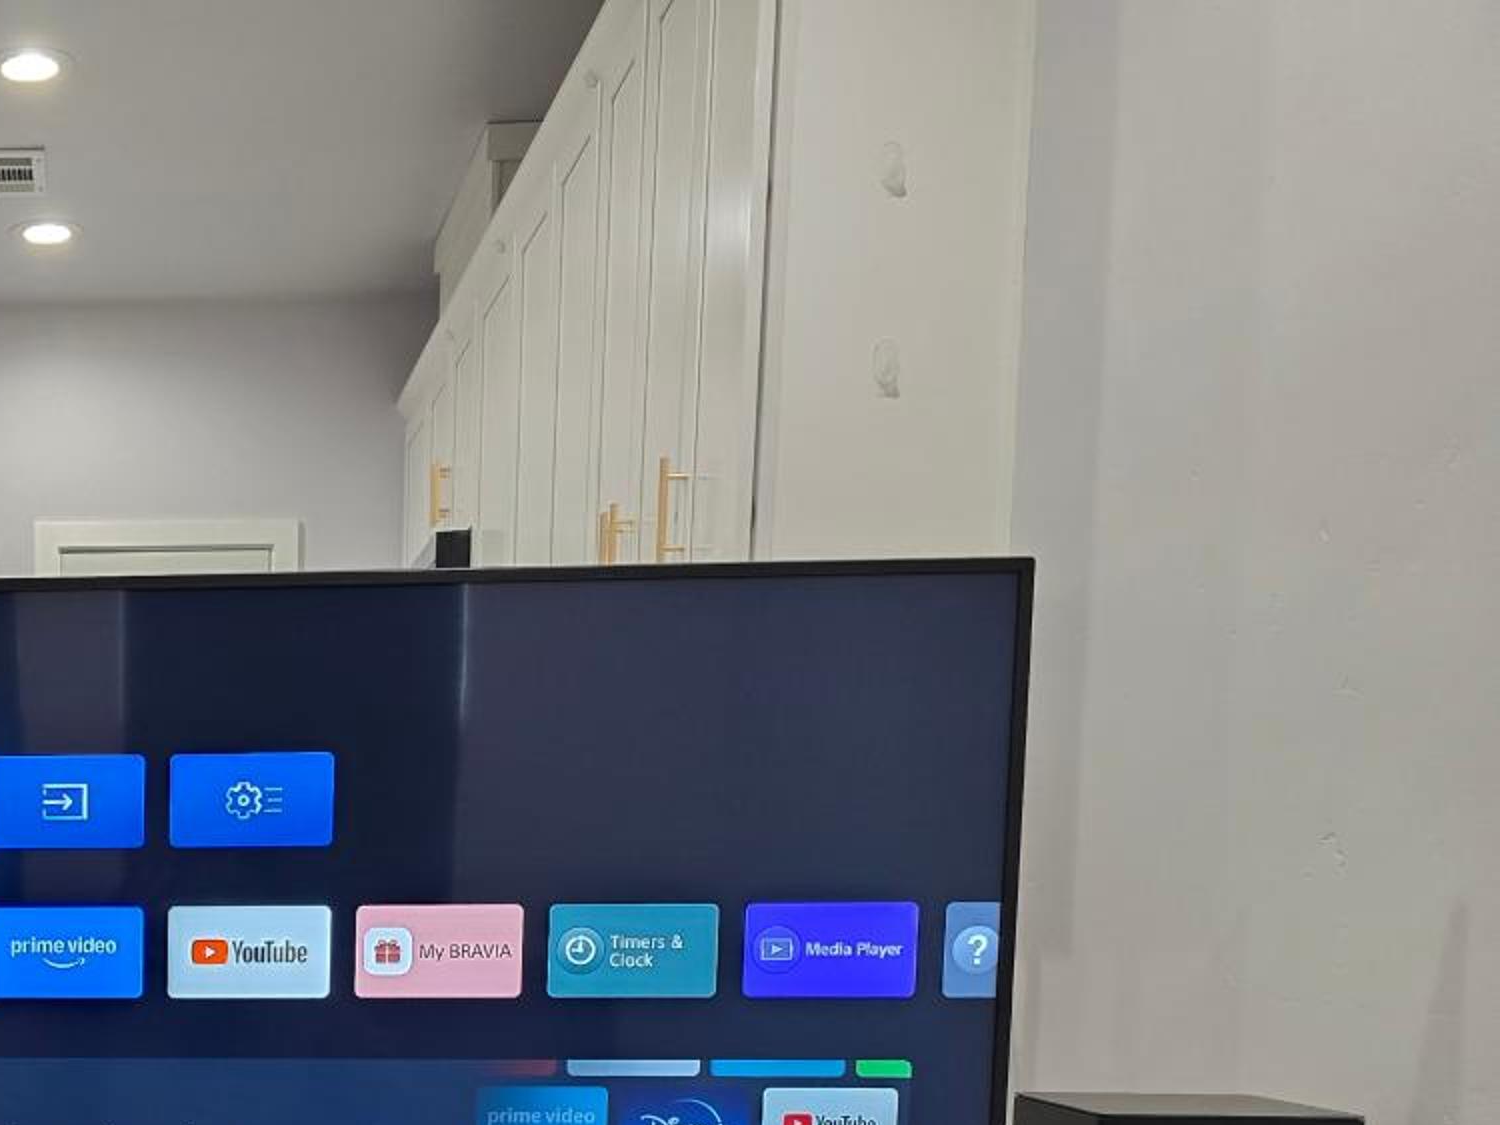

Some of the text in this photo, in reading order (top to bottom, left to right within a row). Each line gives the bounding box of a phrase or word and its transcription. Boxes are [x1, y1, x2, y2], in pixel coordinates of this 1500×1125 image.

[11, 937, 117, 957] prime video
[610, 935, 683, 949] Timers &
[805, 941, 903, 959] Media Player
[231, 940, 308, 963] YouTube
[419, 943, 513, 961] My BRAVIA
[610, 953, 653, 967] Clock
[546, 1106, 595, 1125] video
